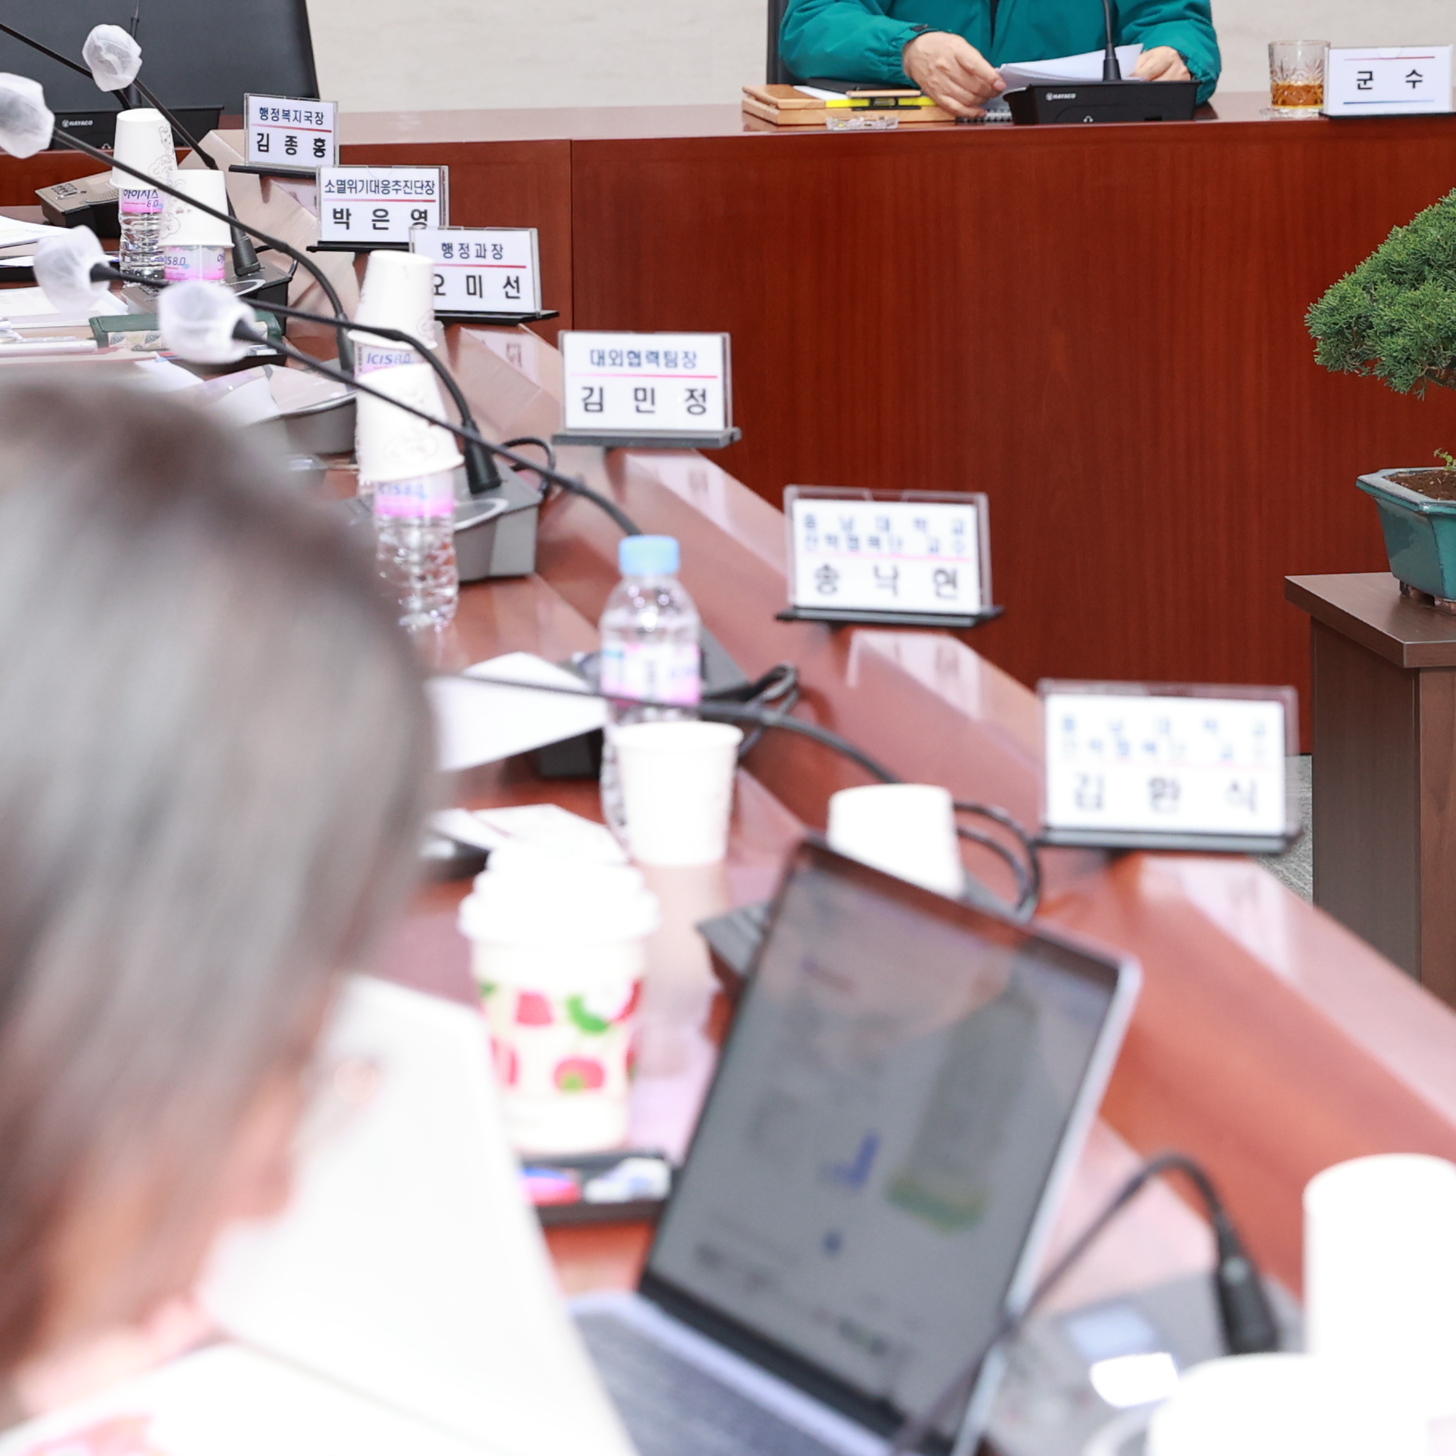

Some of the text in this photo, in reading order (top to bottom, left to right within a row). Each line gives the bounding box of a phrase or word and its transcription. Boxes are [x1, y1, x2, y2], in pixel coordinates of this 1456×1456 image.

[1355, 68, 1424, 91] 군수
[259, 106, 325, 126] 행정복지국장
[256, 132, 326, 159] 김종홍
[324, 178, 436, 196] 소멸위기대응추진단장
[440, 242, 504, 261] 행정과장
[589, 348, 698, 370] 대외협력팀장
[580, 385, 707, 416] 김민정
